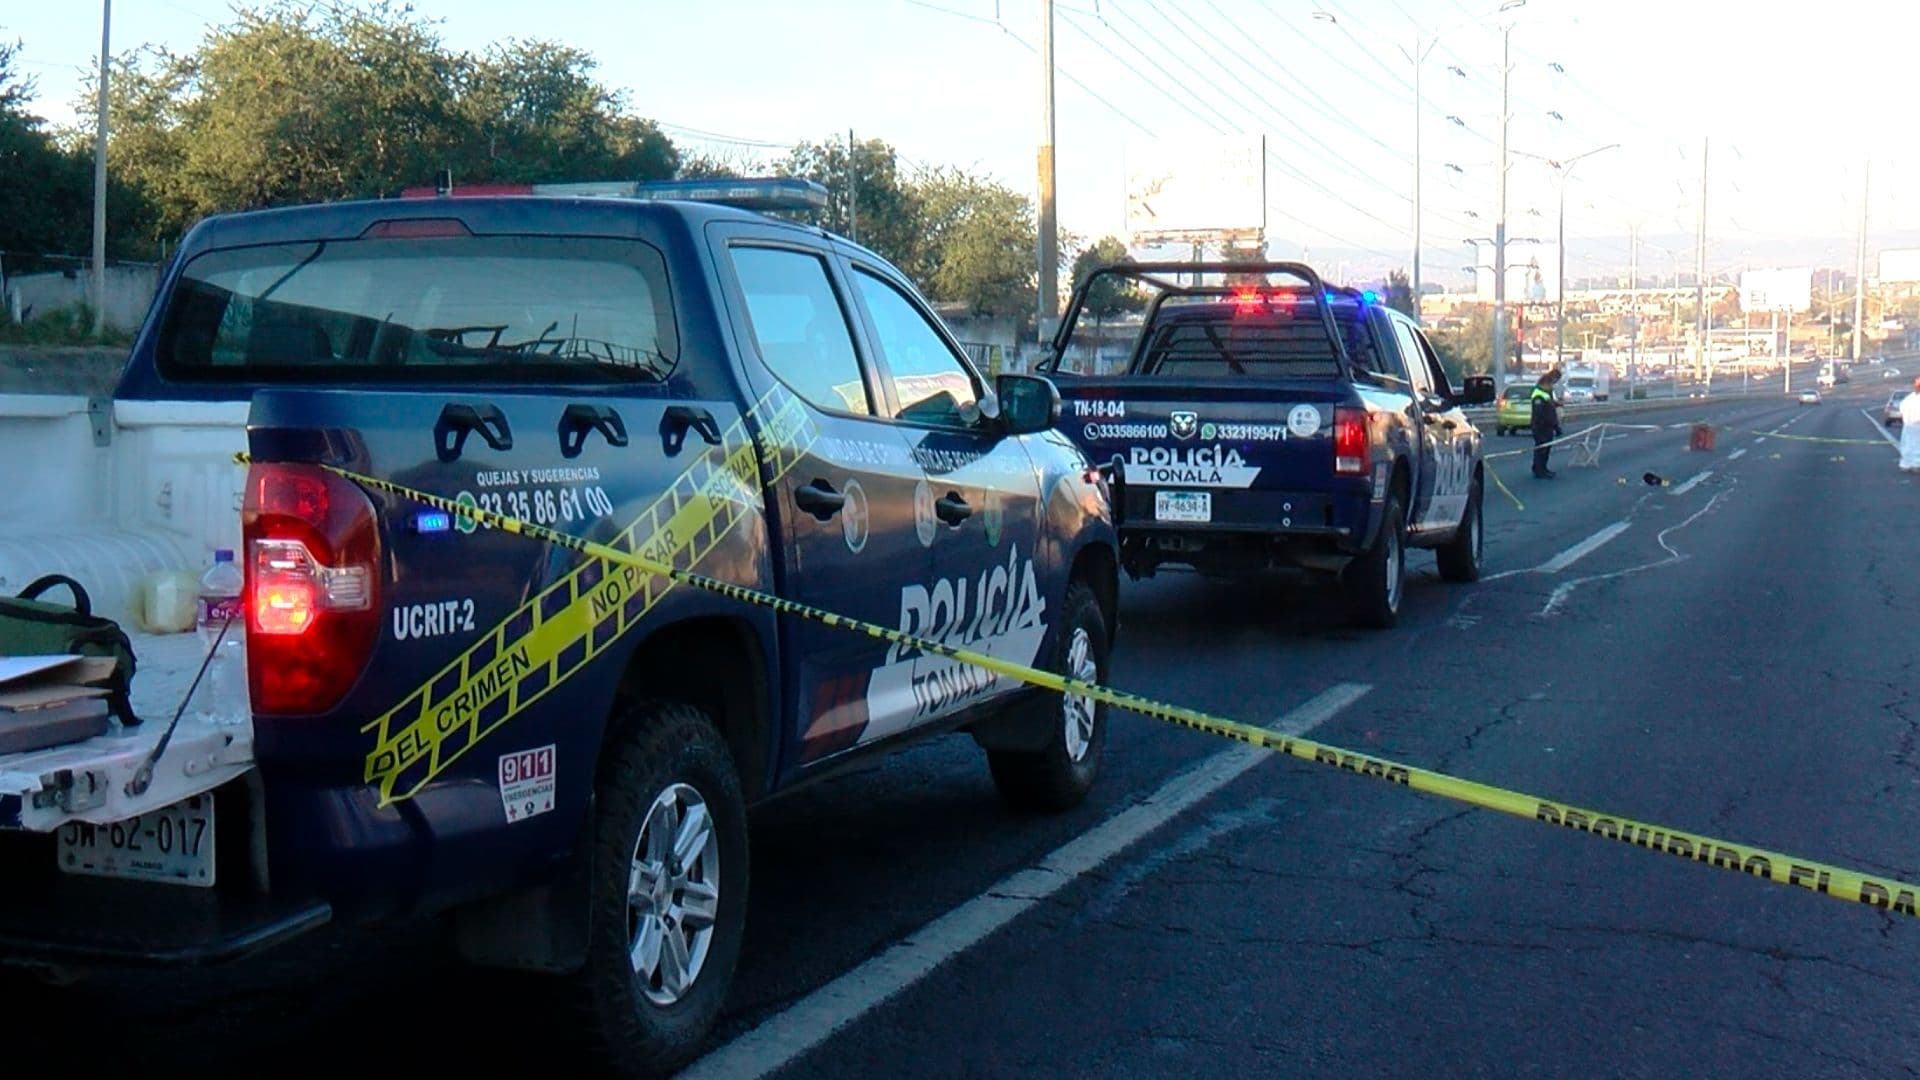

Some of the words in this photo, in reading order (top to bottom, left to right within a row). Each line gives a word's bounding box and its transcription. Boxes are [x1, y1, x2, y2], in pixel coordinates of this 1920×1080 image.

[1074, 400, 1126, 418] TN-18-04
[1100, 424, 1167, 439] 3335866100
[1218, 425, 1287, 441] 3323199471
[1130, 443, 1246, 469] POLICÍA
[477, 470, 519, 486] QUEJAS
[522, 470, 529, 483] Y
[531, 467, 600, 484] SUGERENCIAS
[507, 491, 531, 524] 35
[534, 489, 557, 525] 86
[559, 487, 585, 521] 61
[585, 486, 614, 517] 00
[590, 580, 620, 618] NO
[885, 542, 1047, 666] POLICÍA
[393, 598, 476, 641] UCRIT-2
[372, 728, 430, 775] DEL
[436, 645, 531, 734] CRIMEN
[505, 751, 549, 782] 911
